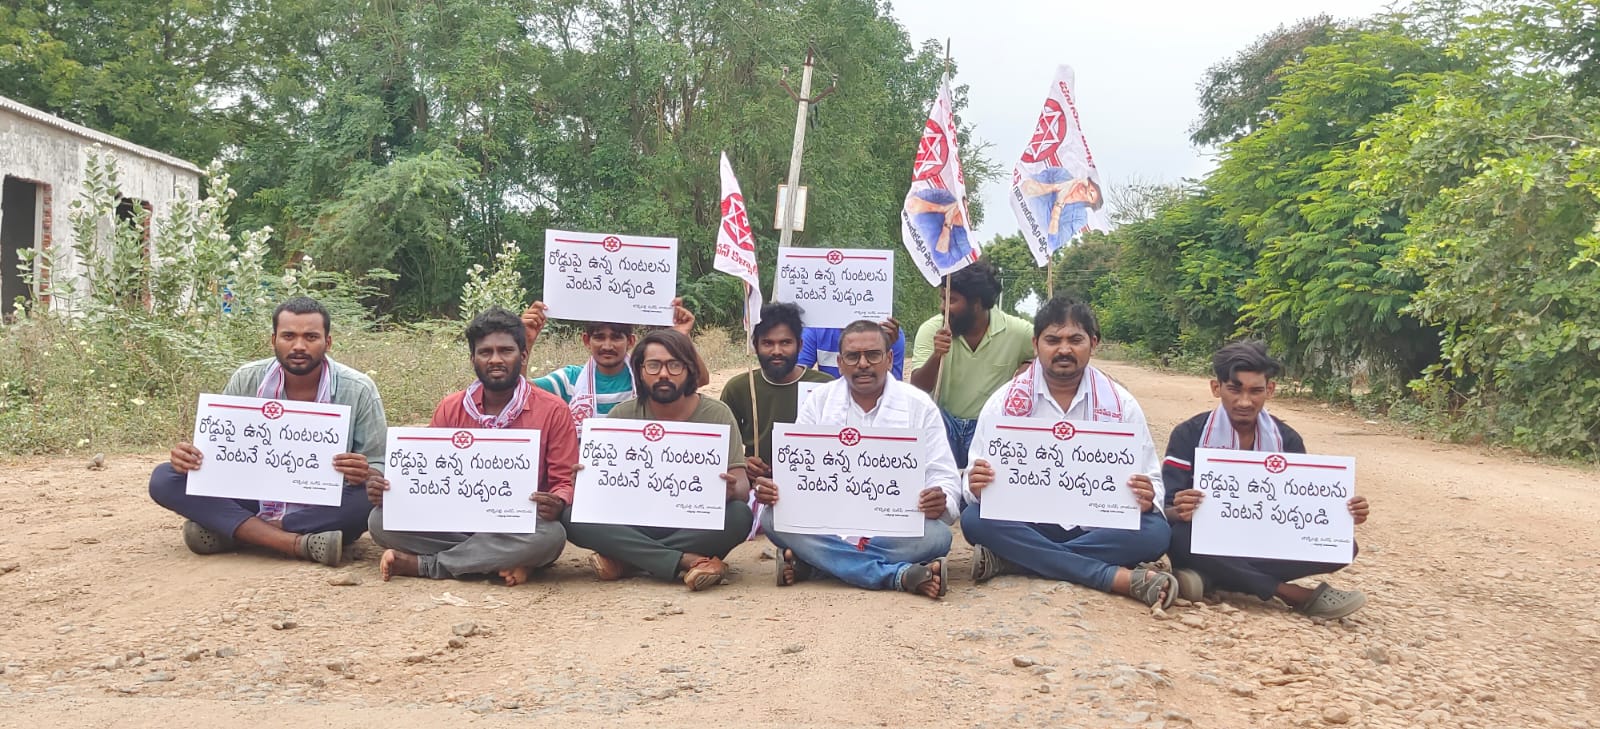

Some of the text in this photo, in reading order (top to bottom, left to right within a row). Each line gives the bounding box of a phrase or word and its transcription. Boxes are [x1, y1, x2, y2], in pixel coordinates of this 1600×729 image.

[548, 249, 671, 276] రోడ్డుపై ఉన్న గుంటలను
[565, 275, 602, 291] వెంటనే
[780, 264, 887, 286] రోడ్డుపై ఉన్న గుంటలను
[795, 285, 827, 300] వెంటనే
[199, 415, 340, 446] రోడ్డుపై ఉన్న గుంటలను
[216, 445, 258, 464] వెంటనే
[389, 448, 531, 476] రోడ్డుపై ఉన్న గుంటలను
[582, 440, 721, 469] రోడ్డుపై ఉన్న గుంటలను
[777, 445, 918, 473] రోడ్డుపై ఉన్న గుంటలను
[988, 437, 1135, 468] రోడ్డుపై ఉన్న గుంటలను
[409, 476, 451, 495] వెంటనే
[598, 469, 640, 488] వెంటనే
[797, 473, 839, 492] వెంటనే
[1008, 467, 1051, 486] వెంటనే
[1199, 471, 1347, 501] రోడ్డుపై ఉన్న గుంటలను
[1220, 501, 1264, 520] వెంటనే
